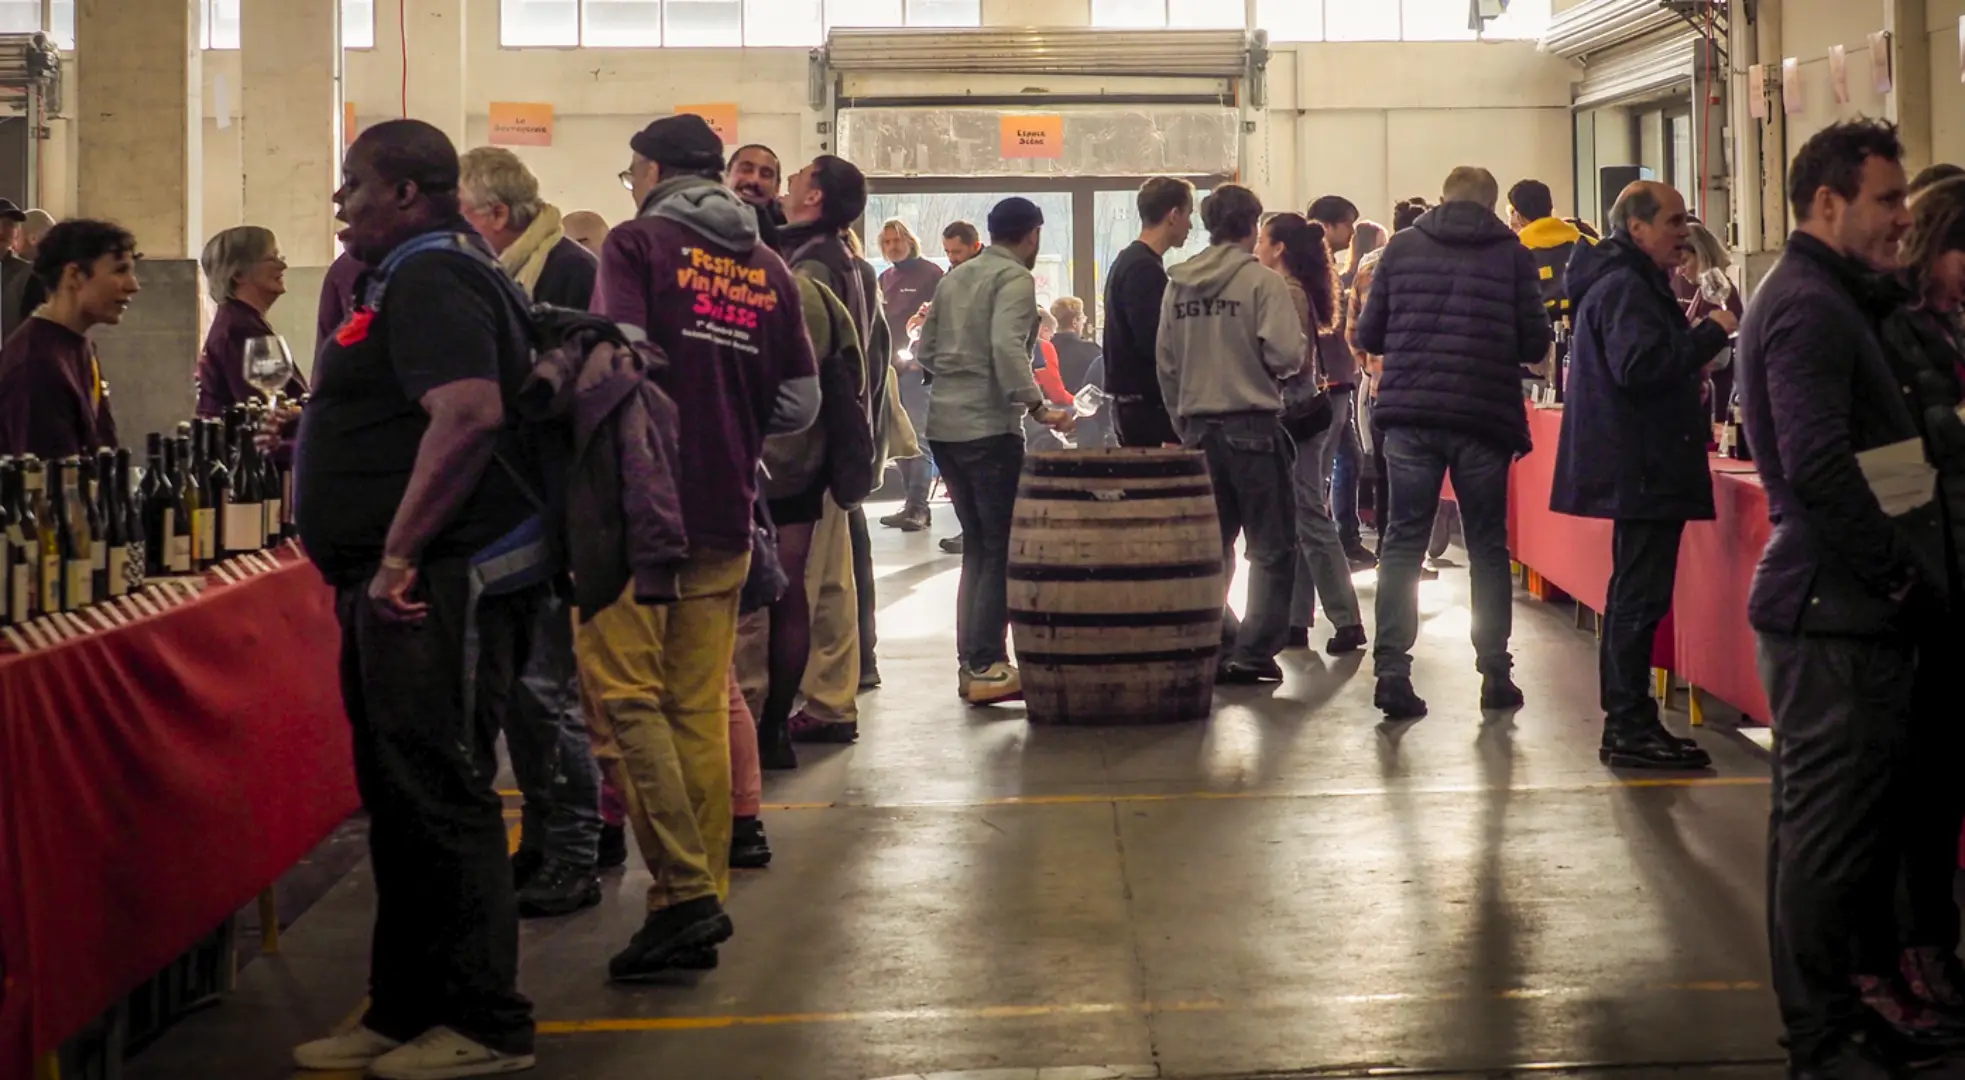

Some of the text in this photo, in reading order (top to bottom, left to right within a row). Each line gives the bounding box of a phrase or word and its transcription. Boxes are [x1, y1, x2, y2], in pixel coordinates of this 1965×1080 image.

[691, 247, 766, 287] Festival
[677, 266, 777, 311] Vin Nature
[692, 293, 758, 329] Suisse
[1173, 297, 1241, 320] EGYPT
